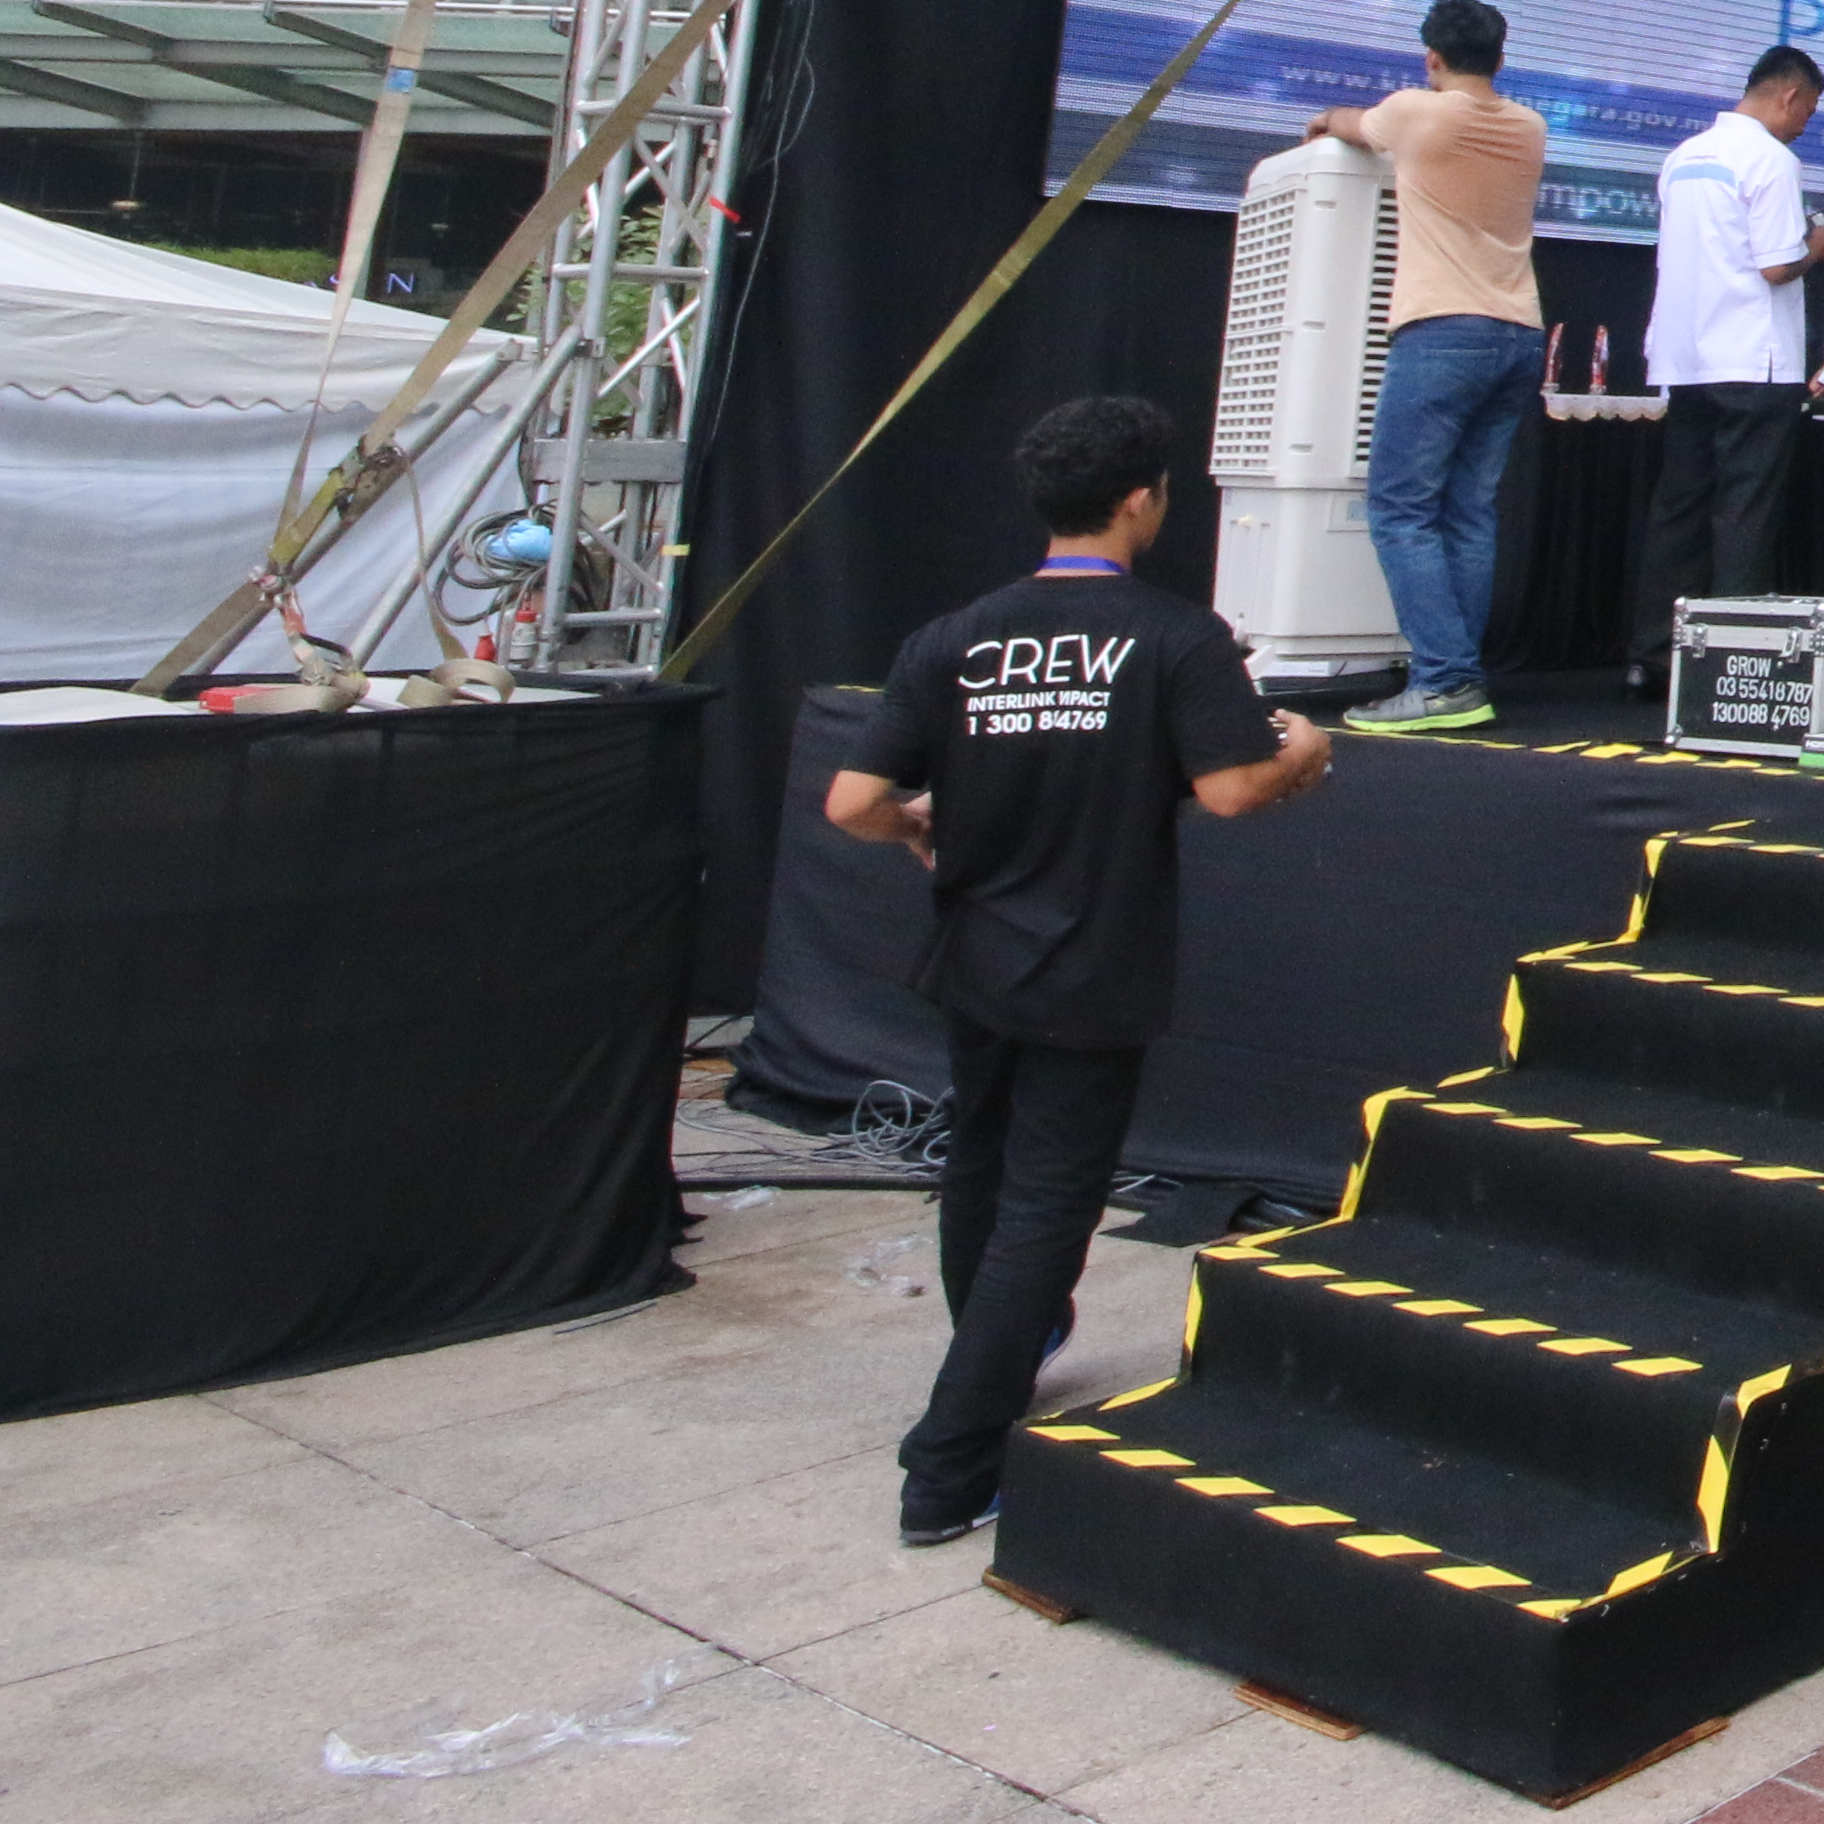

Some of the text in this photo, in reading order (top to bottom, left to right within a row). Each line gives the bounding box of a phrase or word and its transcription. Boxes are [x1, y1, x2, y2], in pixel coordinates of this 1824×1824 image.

[957, 633, 1136, 690] CREW
[1726, 654, 1772, 678] GROW
[1716, 675, 1737, 697] 03
[966, 690, 1057, 713] INTERLINK
[967, 715, 978, 736] 1
[985, 712, 1033, 735] 300
[1712, 701, 1811, 727] 130088 4769
